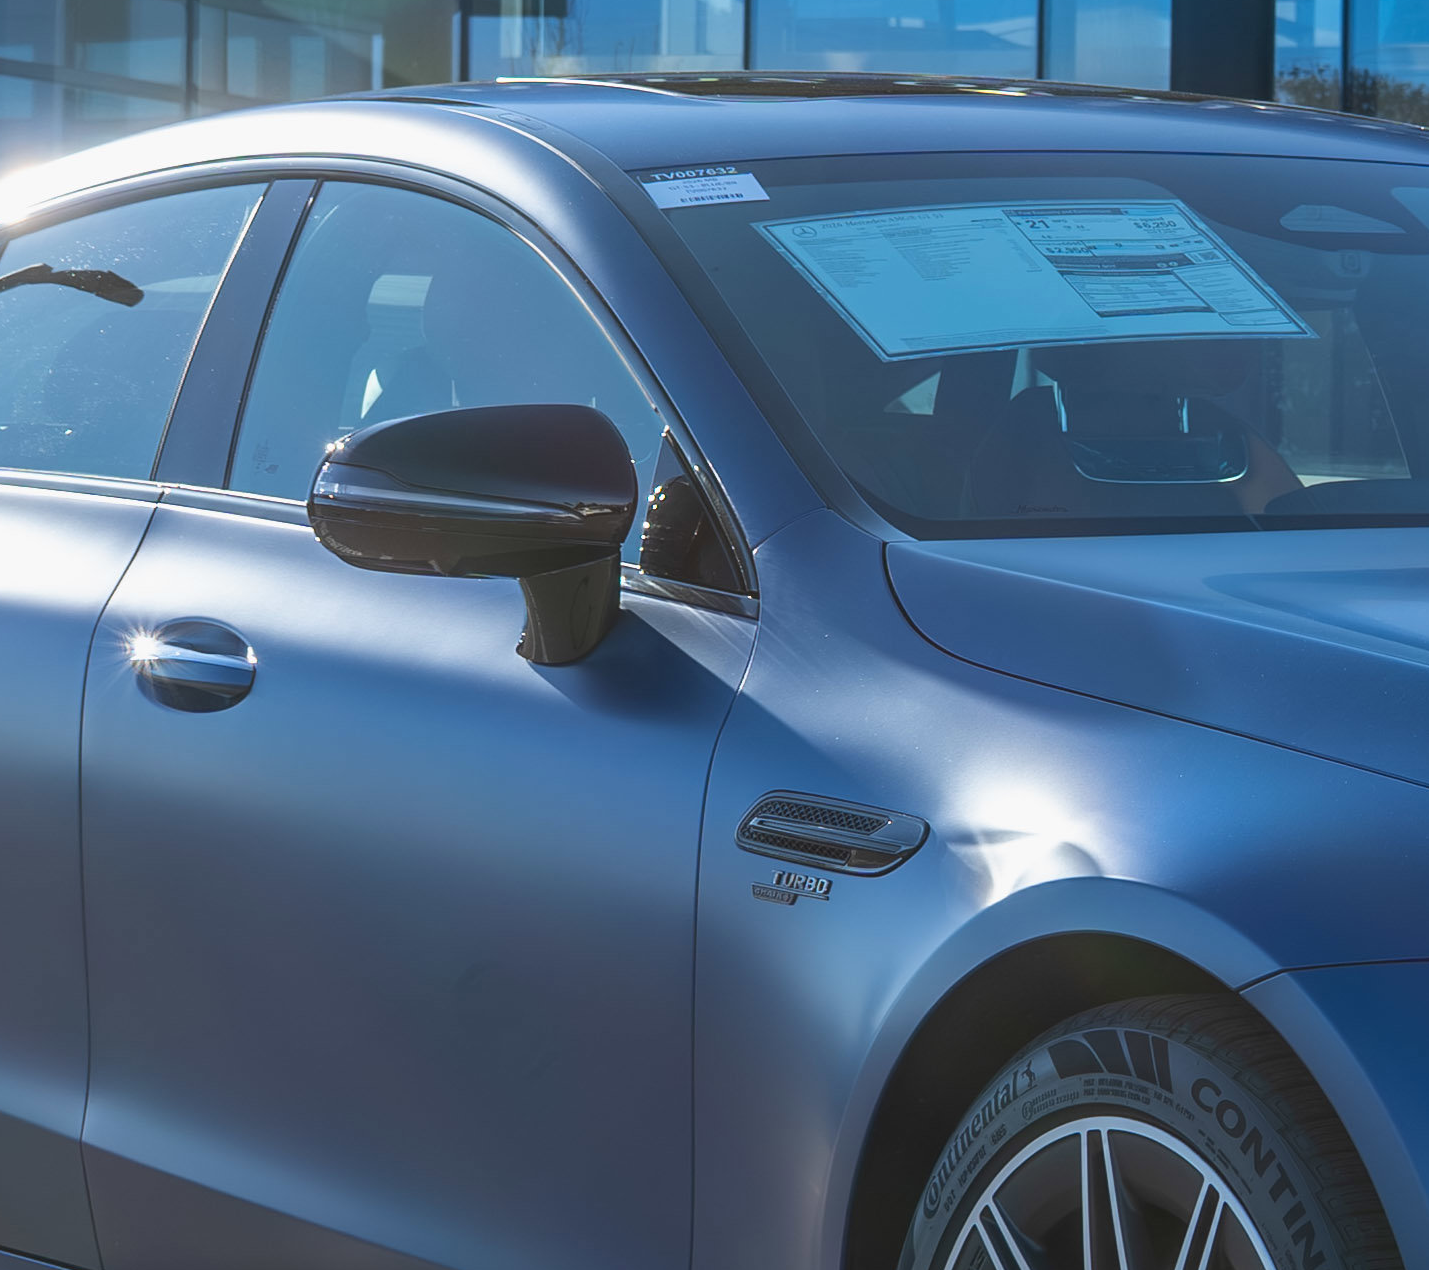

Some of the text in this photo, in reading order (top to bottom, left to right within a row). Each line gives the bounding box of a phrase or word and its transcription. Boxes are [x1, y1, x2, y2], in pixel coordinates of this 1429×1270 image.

[650, 166, 738, 181] TV007632
[1025, 219, 1051, 229] 21
[1133, 220, 1177, 230] $6,250
[771, 869, 831, 895] TURBO
[923, 1069, 1021, 1220] Continental
